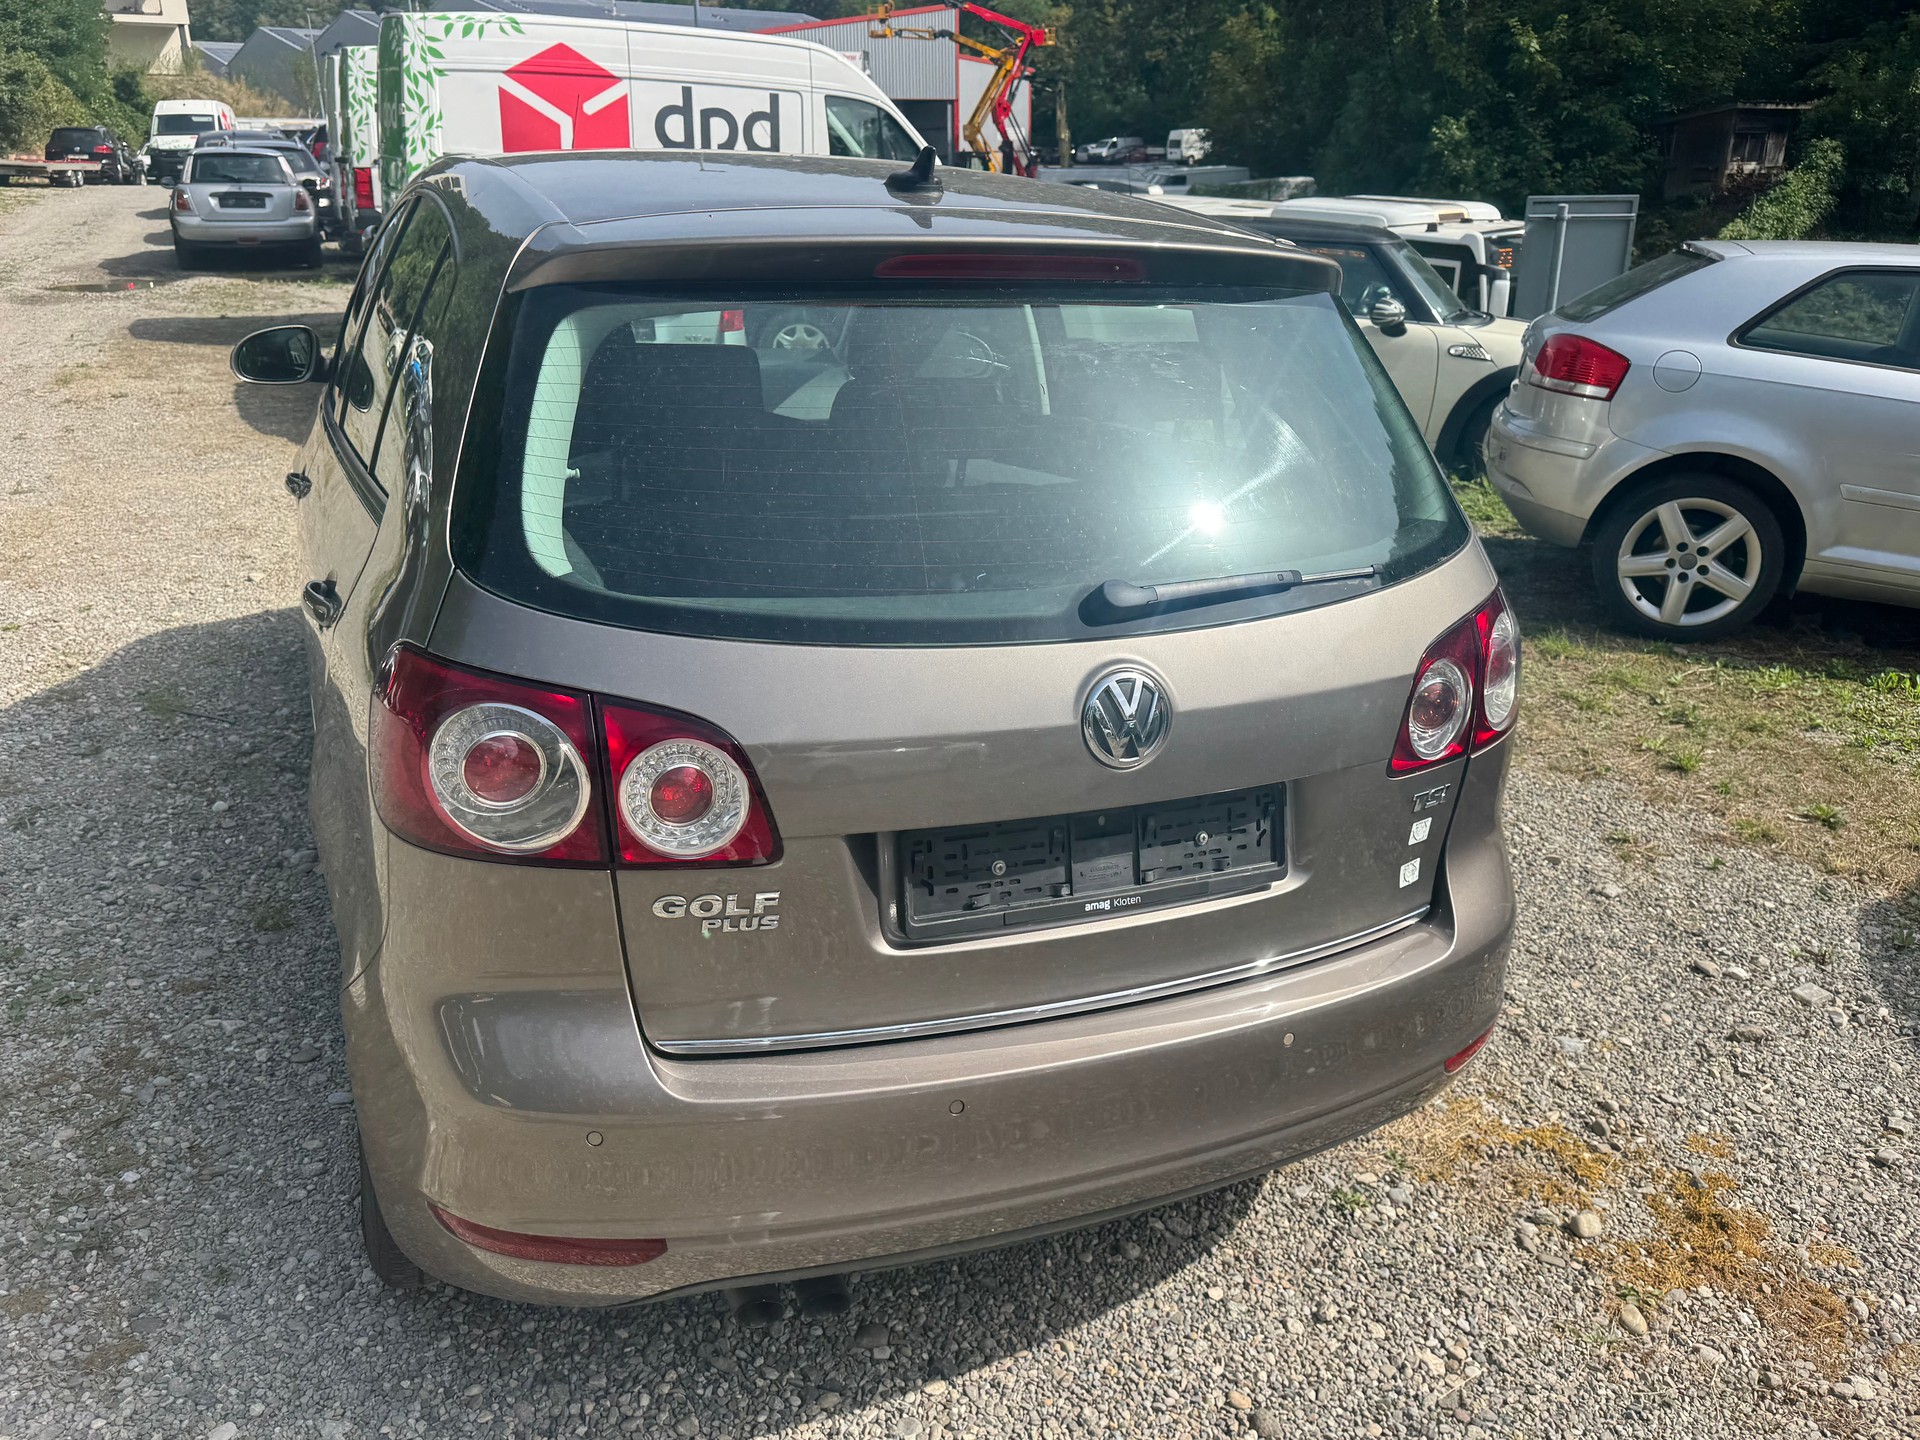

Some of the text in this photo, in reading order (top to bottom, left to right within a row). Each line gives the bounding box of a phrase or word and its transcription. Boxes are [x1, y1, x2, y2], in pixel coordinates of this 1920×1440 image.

[655, 86, 780, 152] dpd
[1083, 668, 1171, 770] VW
[1411, 784, 1451, 813] TSI
[652, 891, 781, 918] GOLF
[1084, 896, 1141, 911] amag Kloten
[701, 914, 780, 933] PLUS
